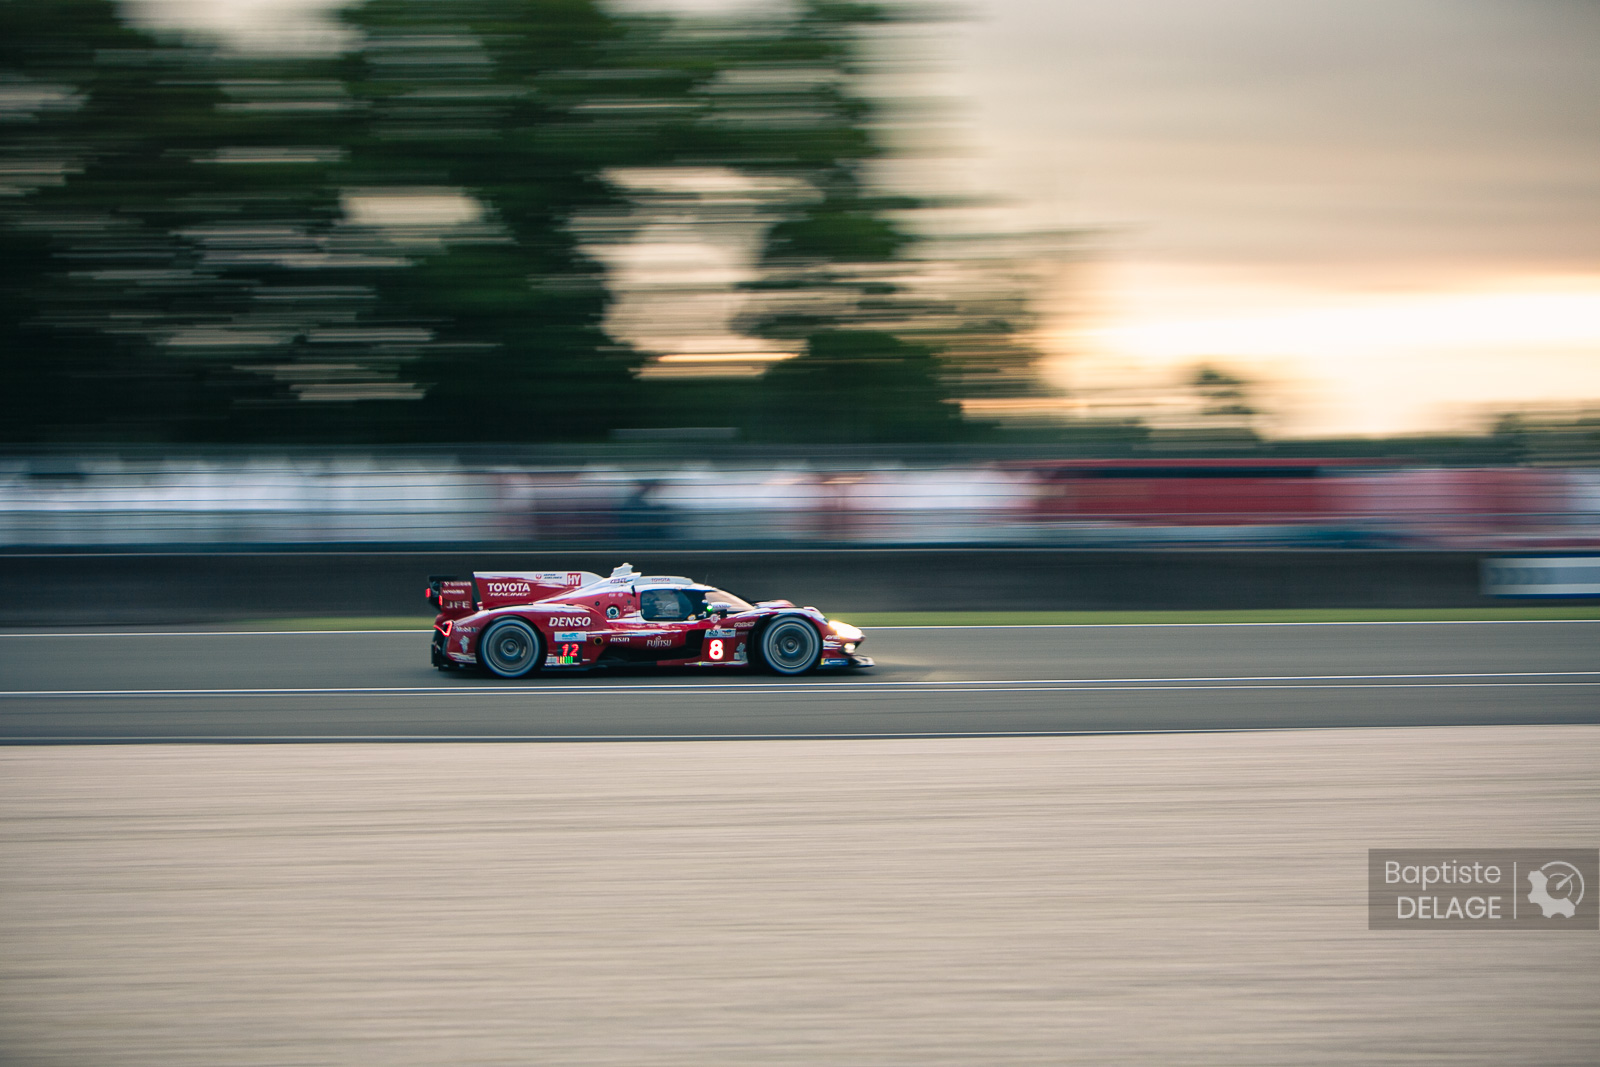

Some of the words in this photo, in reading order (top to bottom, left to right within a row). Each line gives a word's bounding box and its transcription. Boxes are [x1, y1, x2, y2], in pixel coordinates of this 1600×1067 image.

[567, 573, 581, 586] HY
[487, 582, 530, 592] TOYOTA
[548, 616, 591, 626] DENSO
[647, 636, 672, 647] FUJITSU
[562, 644, 579, 657] 12
[709, 639, 724, 660] 8
